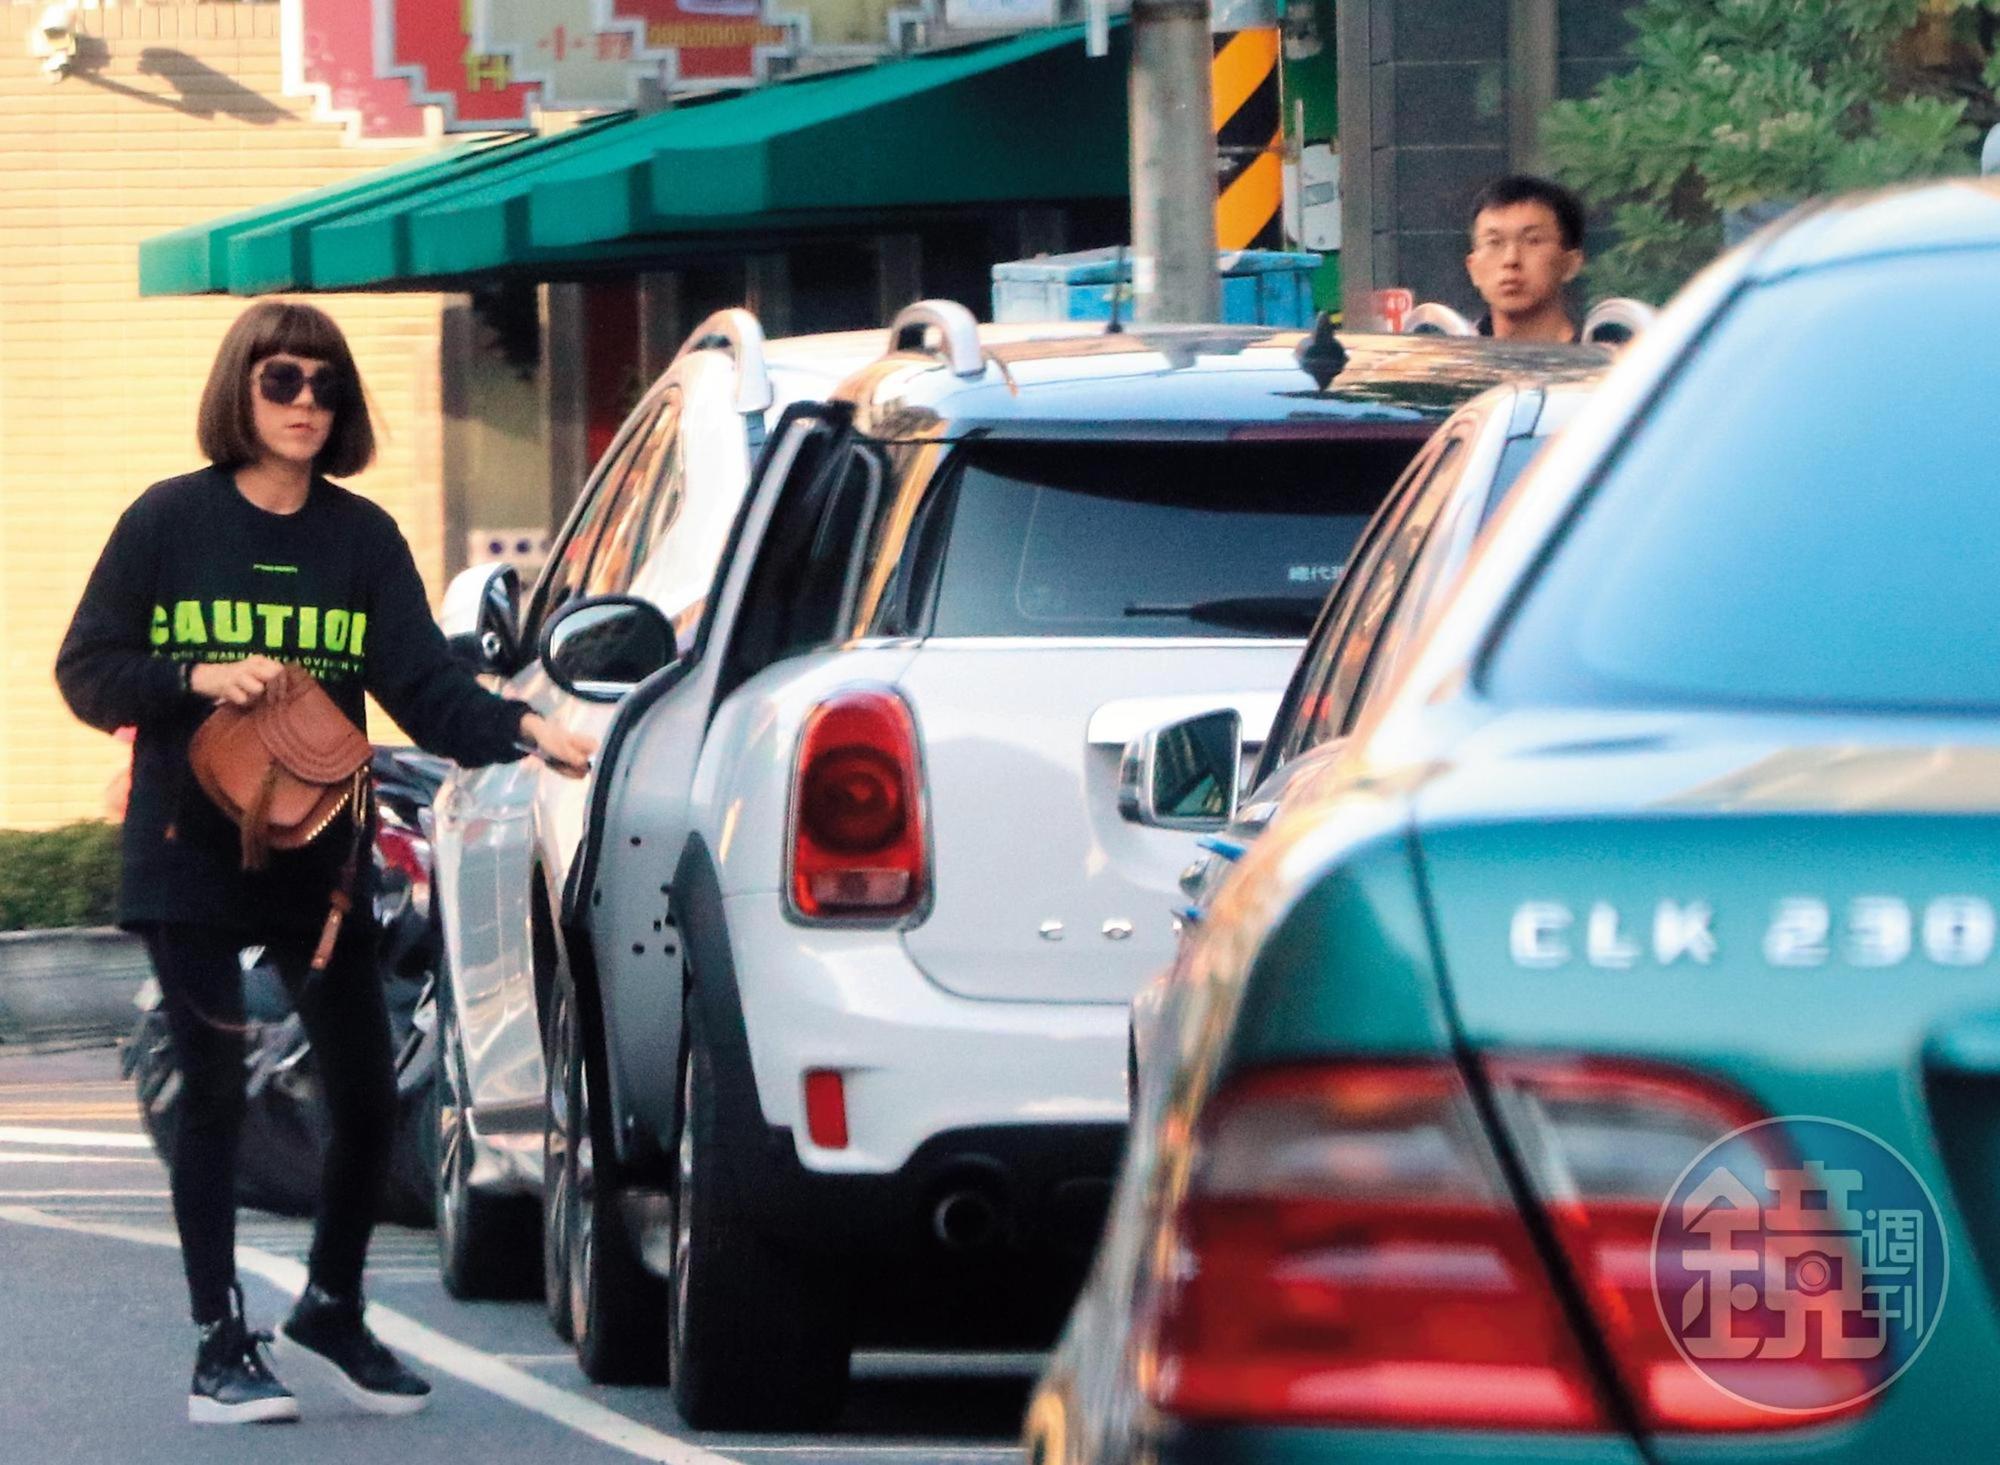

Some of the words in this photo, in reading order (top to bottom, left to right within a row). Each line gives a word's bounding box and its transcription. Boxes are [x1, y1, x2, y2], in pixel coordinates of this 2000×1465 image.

[1039, 919, 1182, 941] CO
[1509, 899, 1717, 969] CLK
[1762, 896, 1996, 968] 230
